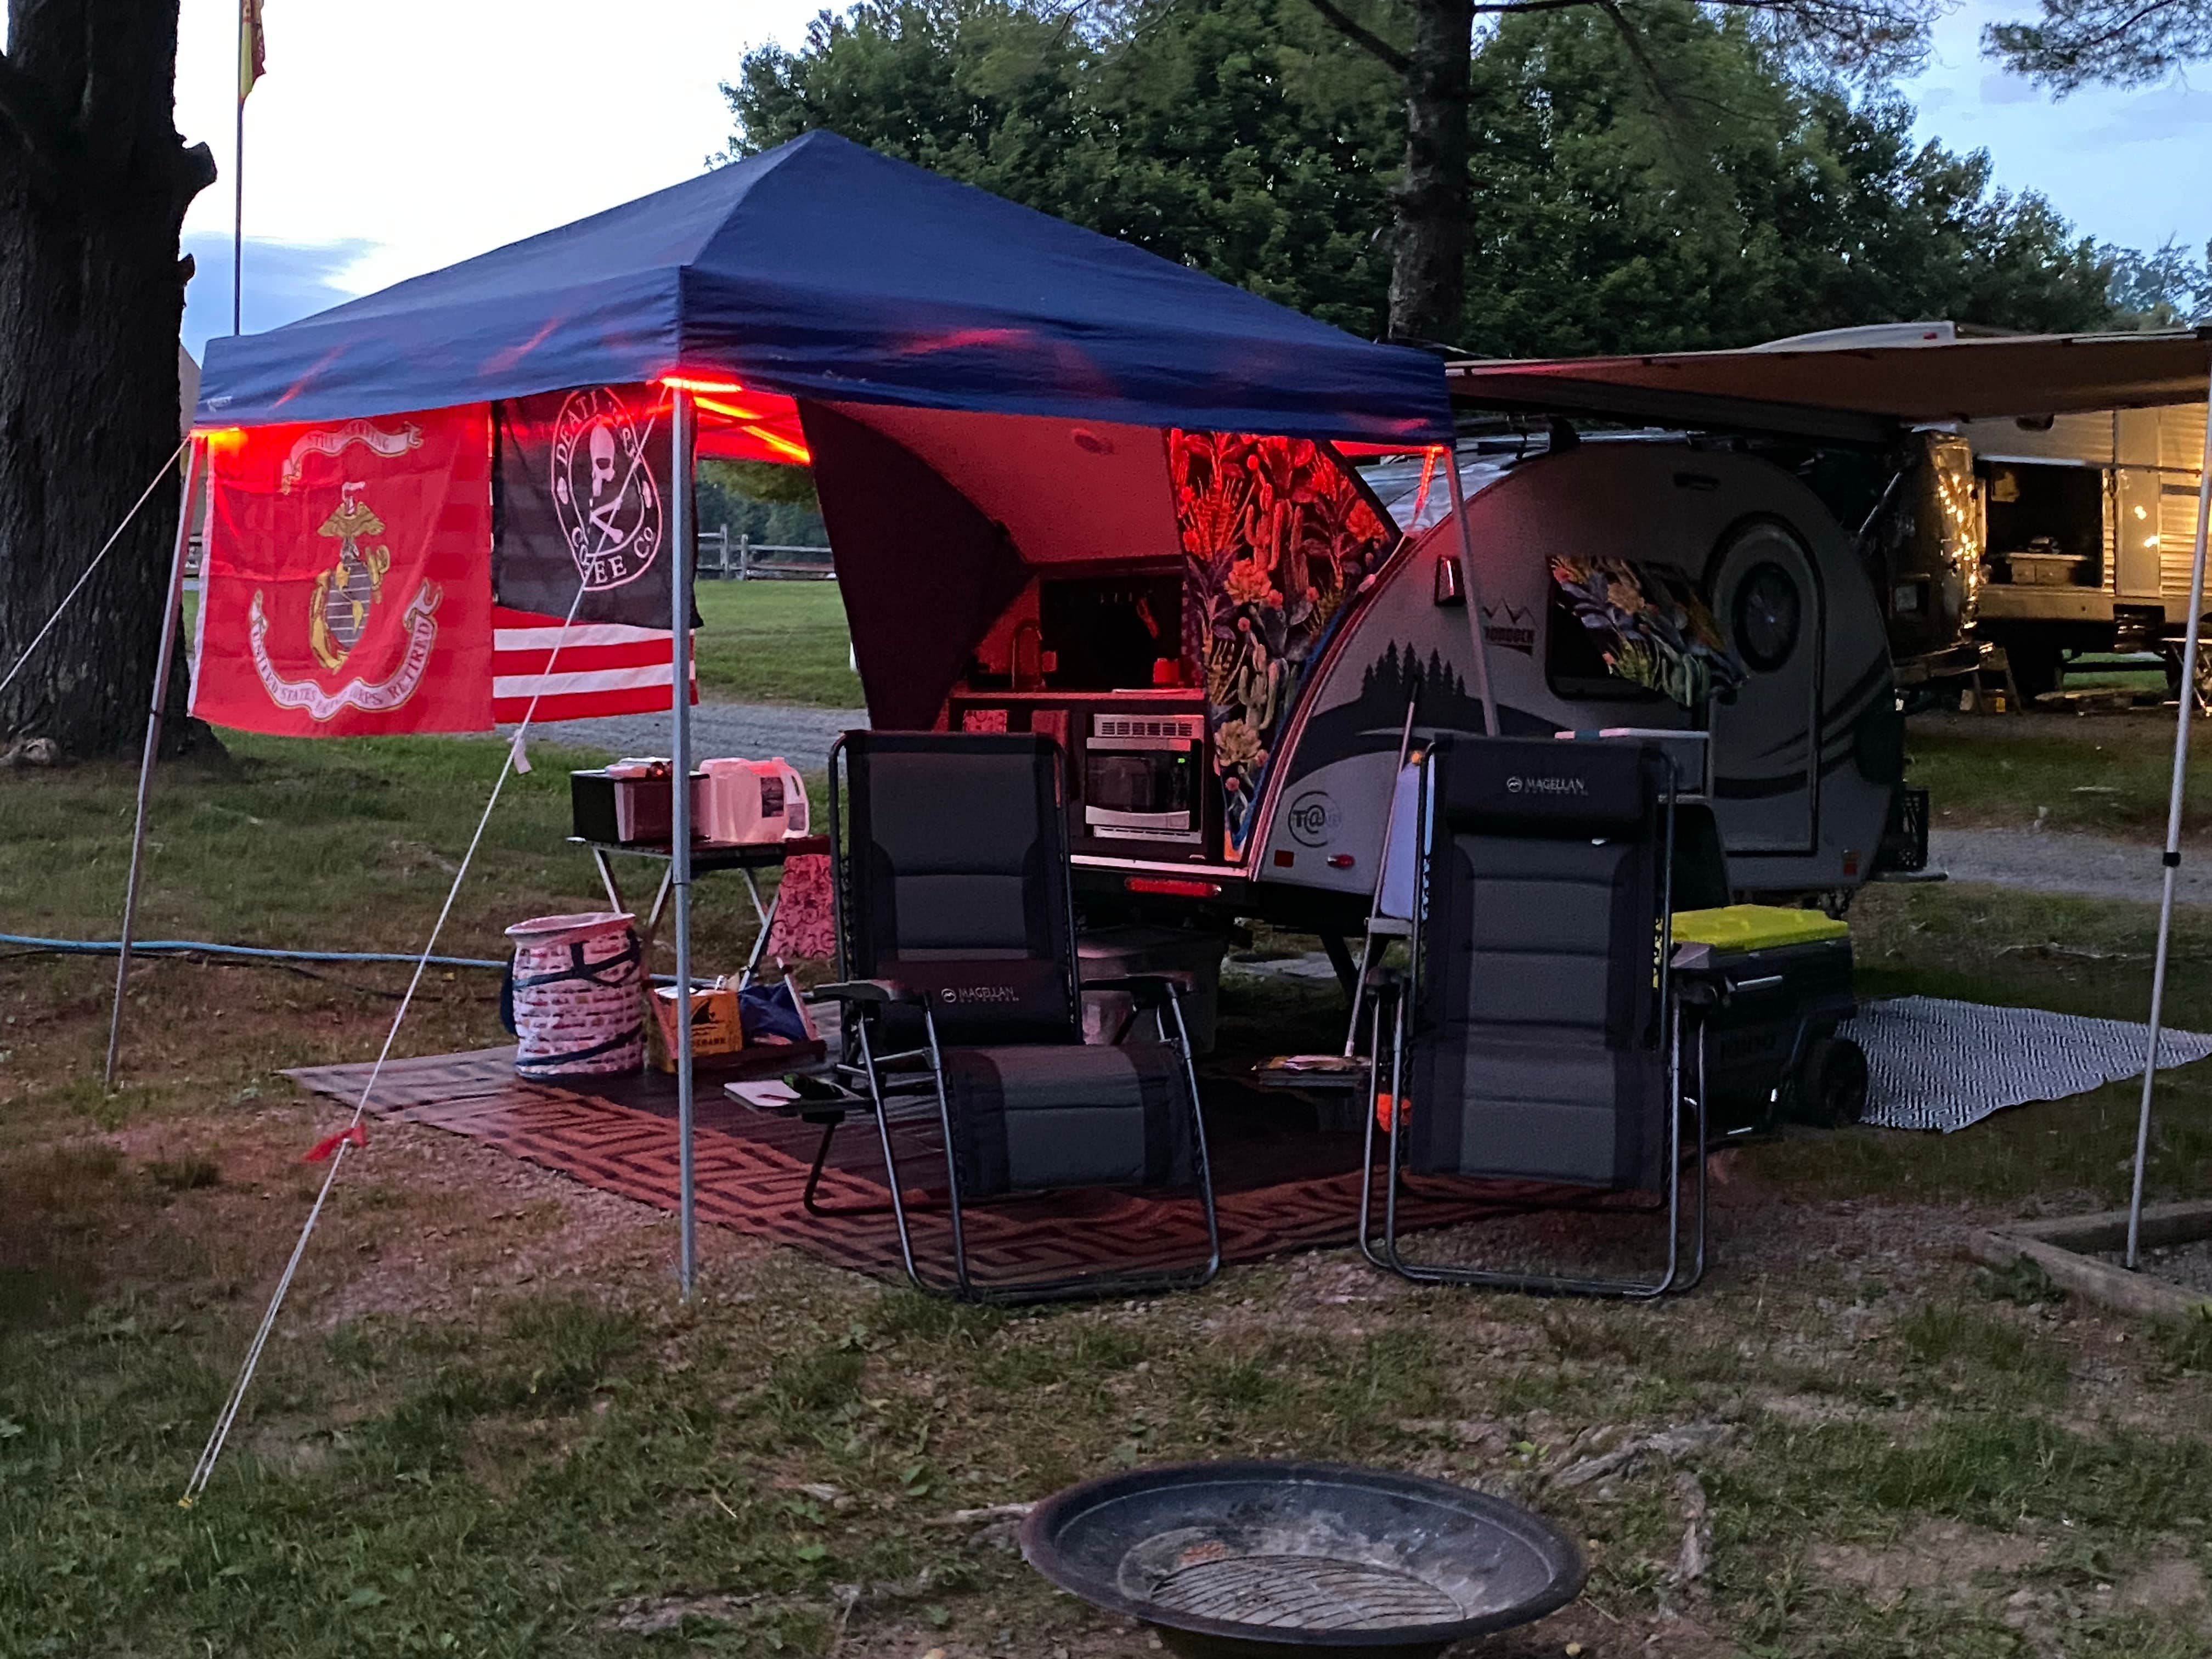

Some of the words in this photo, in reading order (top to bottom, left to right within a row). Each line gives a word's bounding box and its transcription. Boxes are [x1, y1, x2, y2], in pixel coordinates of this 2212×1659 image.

[280, 687, 317, 702] STATES
[387, 622, 430, 699] RETIRED
[1526, 777, 1585, 791] MAGELLAN
[960, 987, 1014, 997] MAGELLAN
